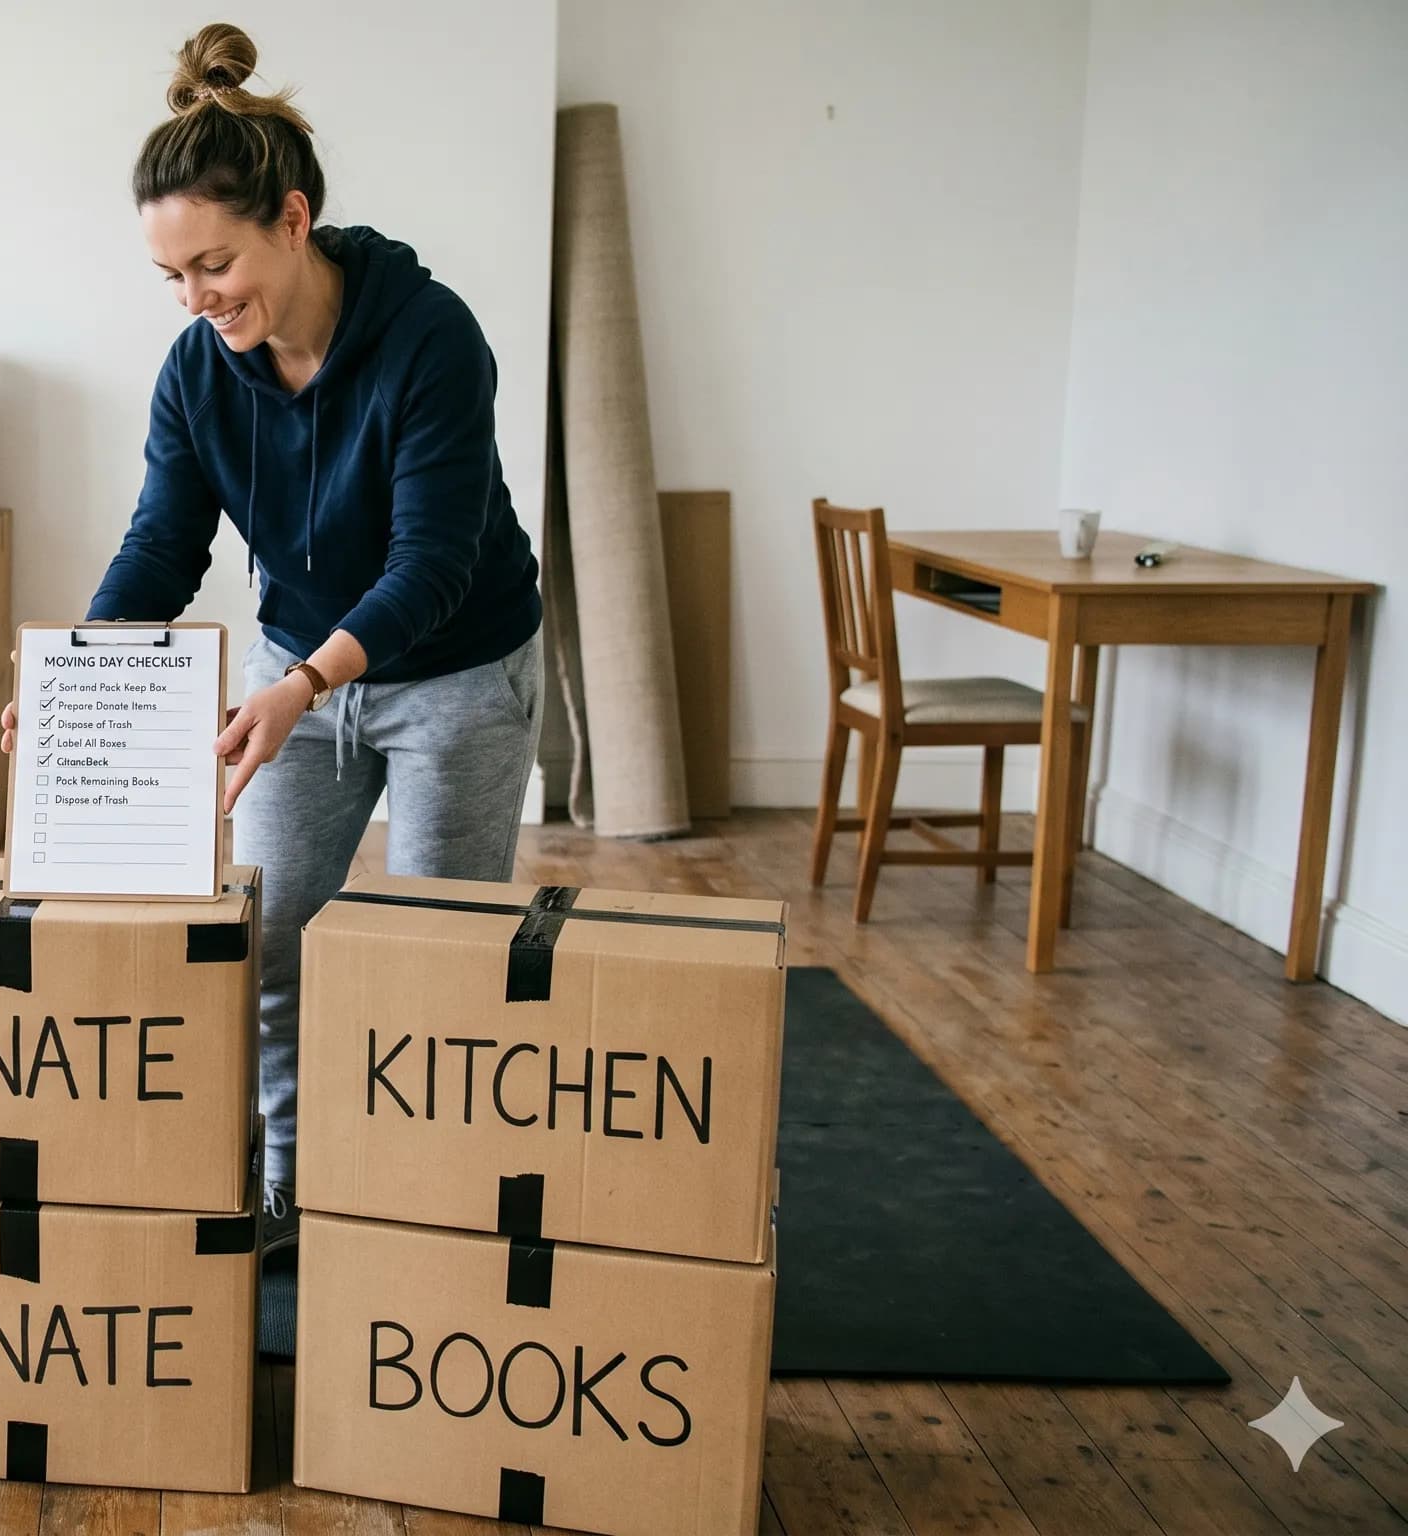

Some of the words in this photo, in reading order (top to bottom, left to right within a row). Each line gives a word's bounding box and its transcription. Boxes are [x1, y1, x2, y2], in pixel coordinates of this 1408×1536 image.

[44, 656, 96, 668] MOVING
[99, 656, 124, 668] DAY
[126, 656, 193, 668] CHECKLIST
[58, 682, 77, 692] Sort
[79, 682, 97, 692] and
[99, 682, 121, 692] Pack
[124, 682, 147, 694] Keep
[149, 683, 167, 692] Box
[58, 701, 93, 713] Prepare
[96, 701, 129, 711] Donate
[131, 701, 157, 711] Items
[58, 719, 94, 731] Dispose
[108, 719, 132, 729] Trash
[57, 738, 82, 748] Label
[84, 738, 97, 748] All
[99, 738, 127, 748] Boxes
[80, 776, 129, 788] Remaining
[131, 776, 159, 787] Books
[55, 794, 90, 806] Dispose
[92, 795, 102, 806] of
[103, 795, 129, 805] Trash
[366, 1027, 713, 1145] KITCHEN
[369, 1320, 692, 1447] BOOKS
